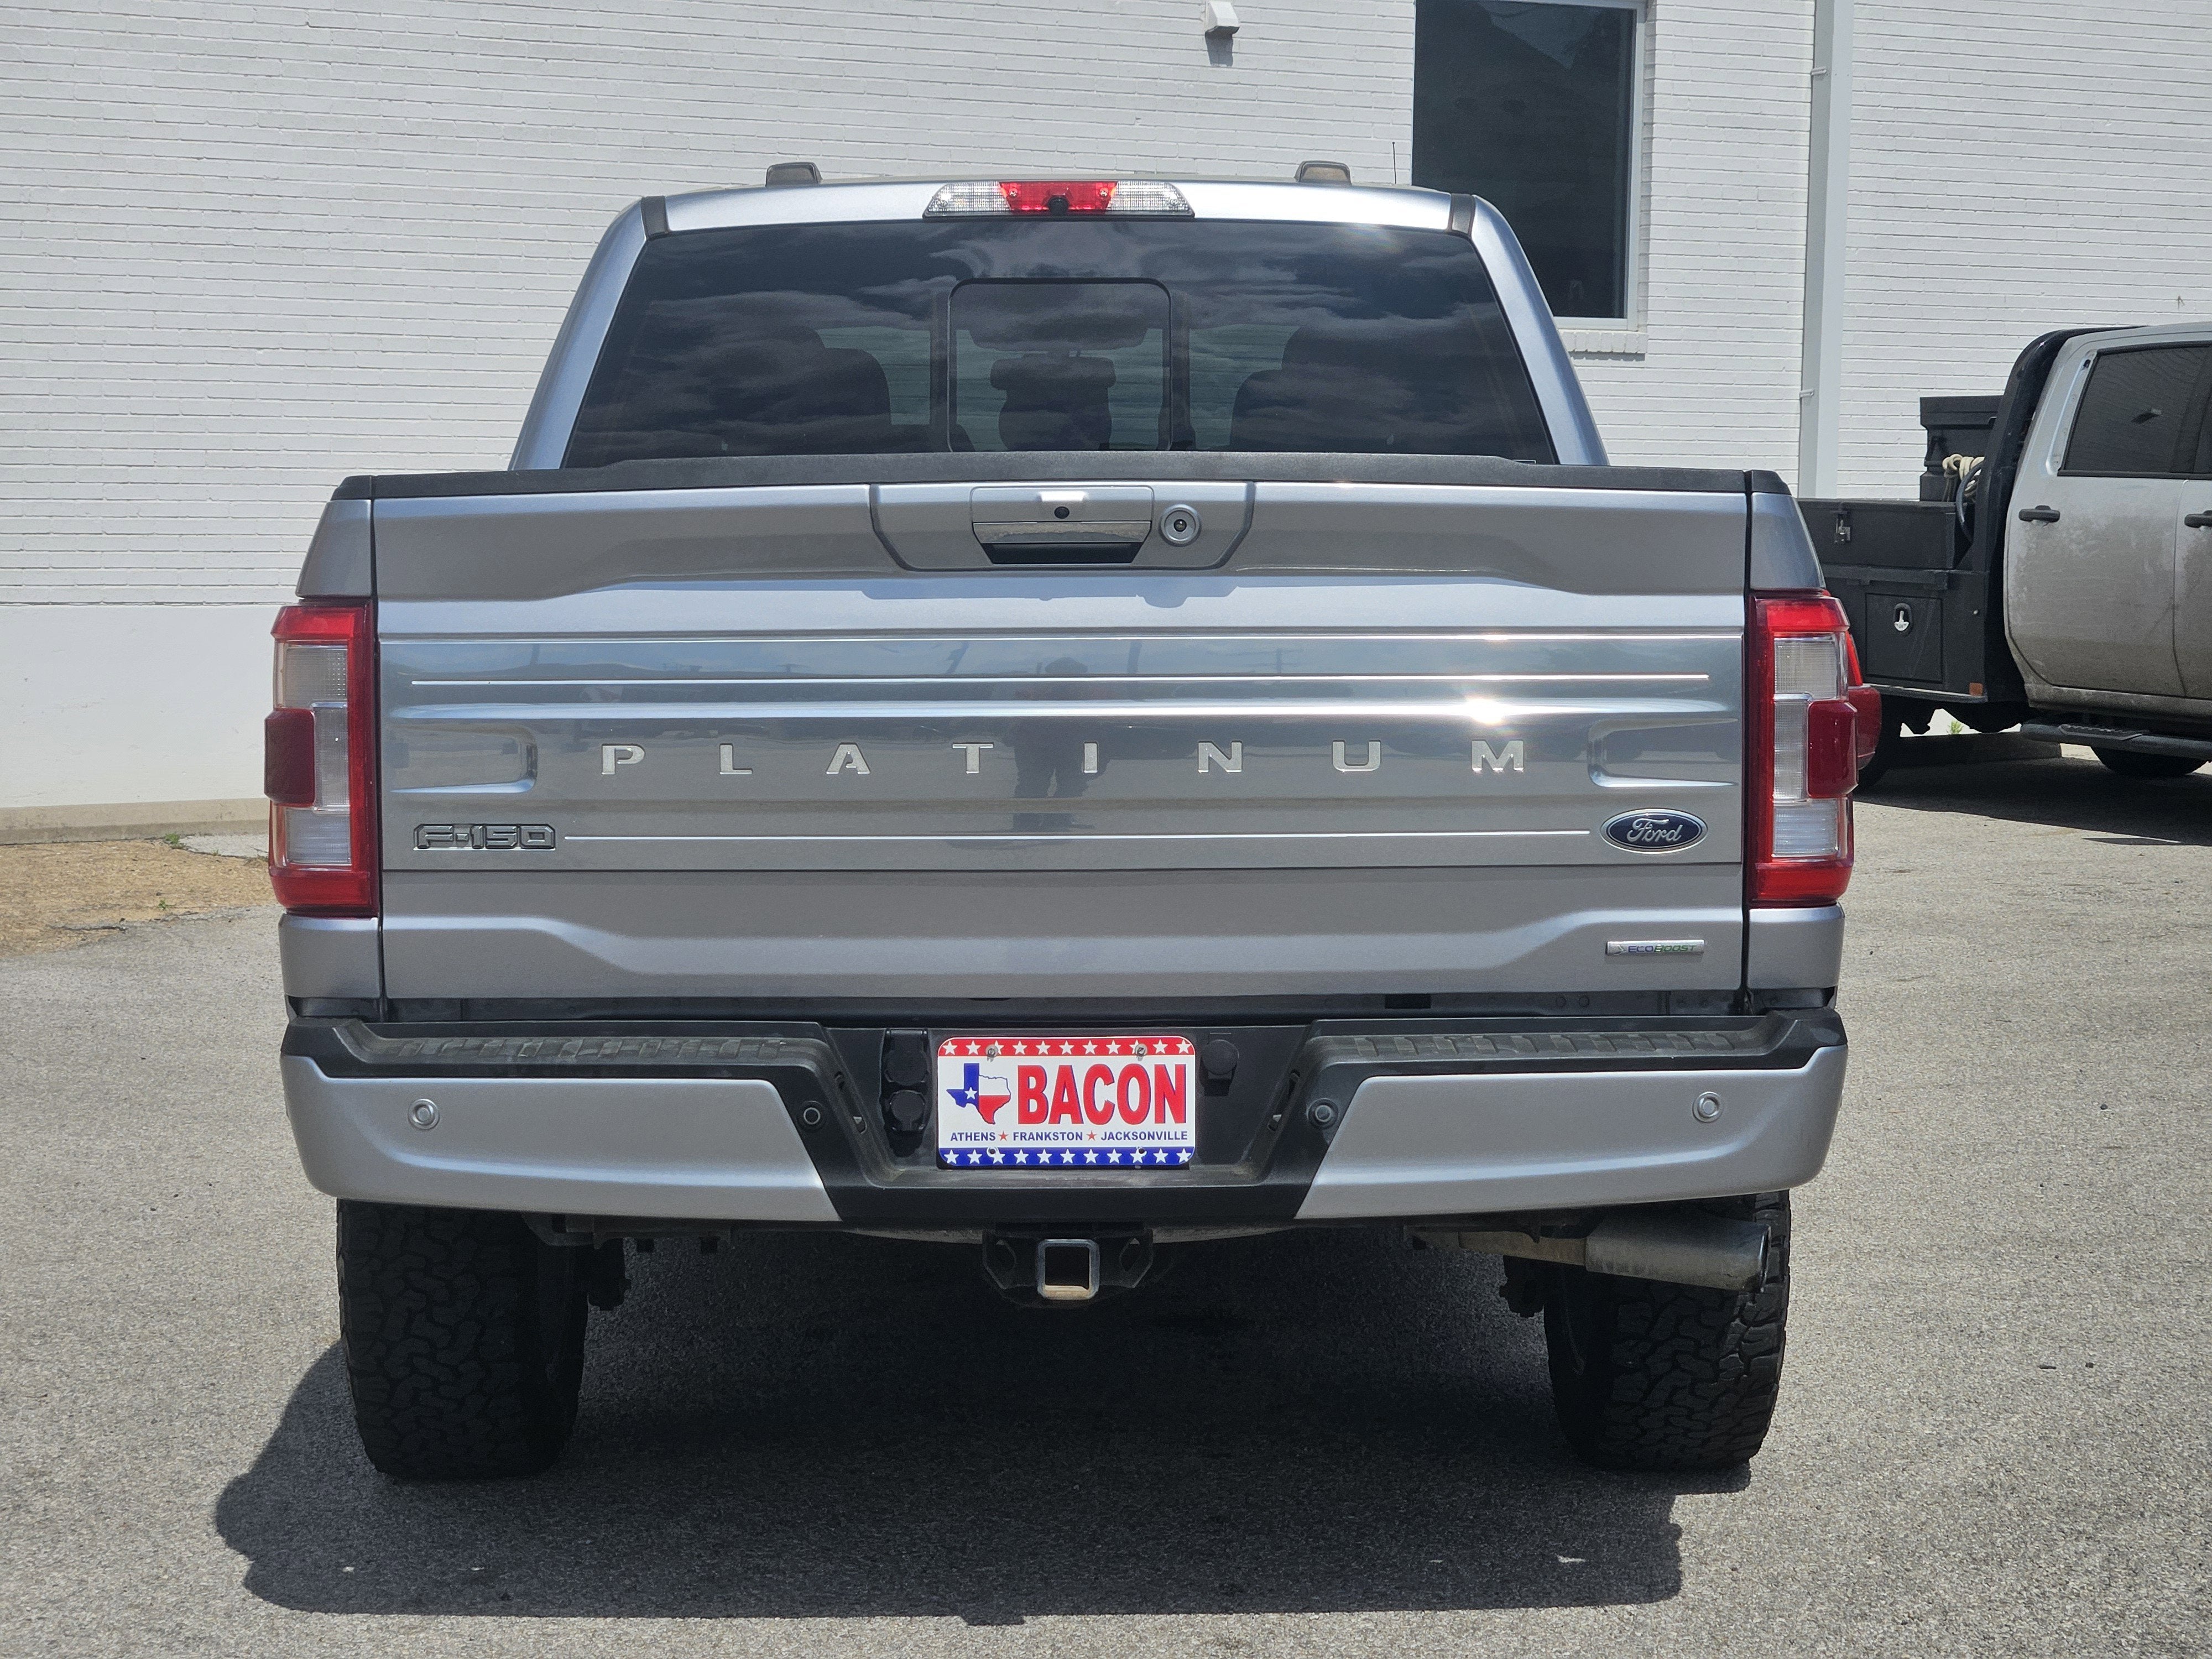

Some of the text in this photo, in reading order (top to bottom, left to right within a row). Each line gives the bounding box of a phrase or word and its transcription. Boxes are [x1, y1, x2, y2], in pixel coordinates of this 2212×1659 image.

[601, 739, 1525, 775] PLATINUM
[414, 823, 555, 851] F-150
[1626, 818, 1683, 842] Ford
[1017, 1063, 1186, 1125] BACON
[950, 1130, 1188, 1141] ATHENS FRANKSTON JACKSONVILLE
